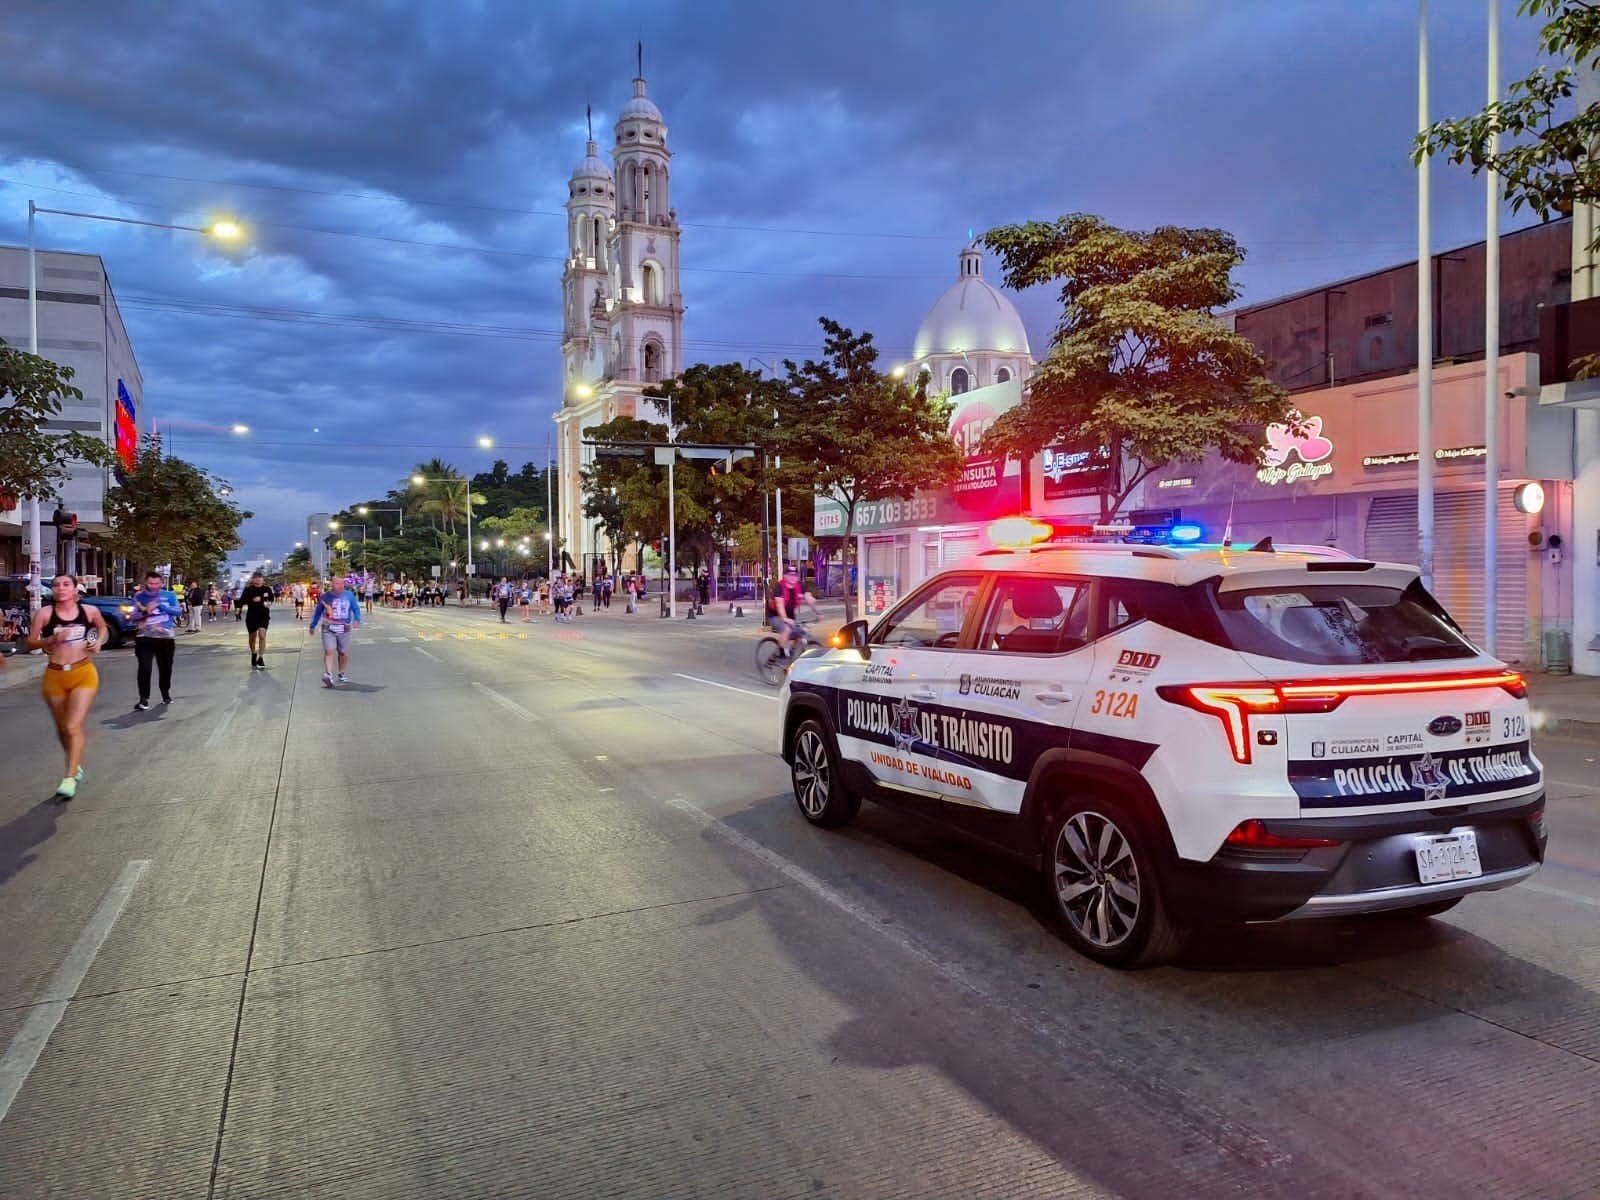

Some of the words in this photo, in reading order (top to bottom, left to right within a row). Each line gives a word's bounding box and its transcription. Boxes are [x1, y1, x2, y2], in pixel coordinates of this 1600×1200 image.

[819, 513, 839, 527] CITAS
[856, 506, 876, 526] 667
[880, 502, 899, 523] 103
[904, 497, 937, 520] 3533
[865, 664, 893, 677] CAPITAL
[1120, 652, 1157, 667] 911
[1091, 690, 1138, 719] 312A
[847, 695, 889, 736] POLICÍA
[921, 711, 939, 747] DE
[941, 711, 1013, 765] TRÁNSITO
[1466, 713, 1490, 726] 911
[1386, 733, 1423, 744] CAPITAL
[871, 751, 903, 771] UNIDAD
[906, 762, 920, 776] DE
[921, 766, 972, 790] VIALIDAD
[1333, 758, 1411, 796] POLICÍA
[1448, 758, 1473, 785] DE
[1467, 748, 1533, 783] TRÁNSITO
